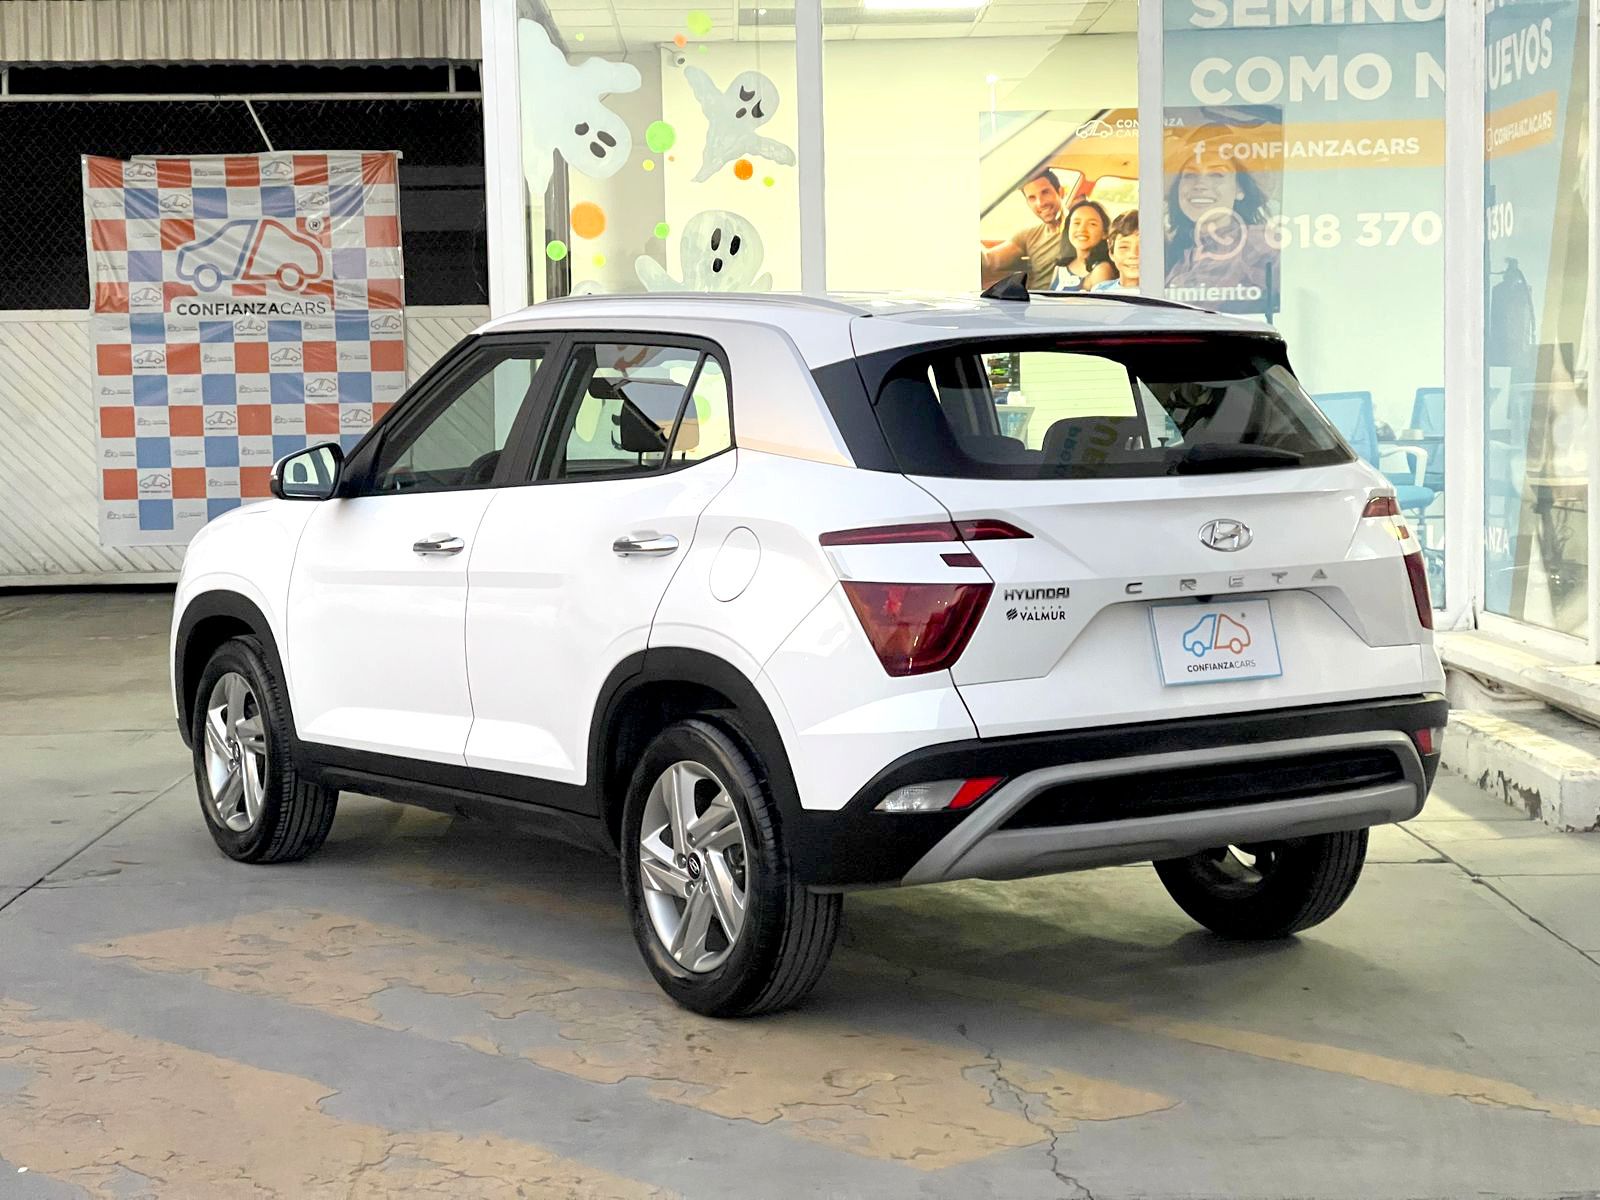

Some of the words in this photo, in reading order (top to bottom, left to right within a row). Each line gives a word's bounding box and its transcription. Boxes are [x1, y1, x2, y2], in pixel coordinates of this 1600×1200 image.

[1488, 17, 1553, 90] UEVOS
[1190, 53, 1392, 105] COMO
[1218, 137, 1420, 160] CONFIANZACARS
[1264, 213, 1341, 249] 618
[1355, 211, 1443, 247] 370
[1164, 282, 1262, 301] imiento
[176, 302, 326, 316] CONFIANZACARS
[1125, 568, 1328, 594] CRETA
[1004, 587, 1070, 601] HYUNDAI
[1020, 611, 1066, 621] VALMUR
[1187, 660, 1256, 673] CONFIANZACARS
